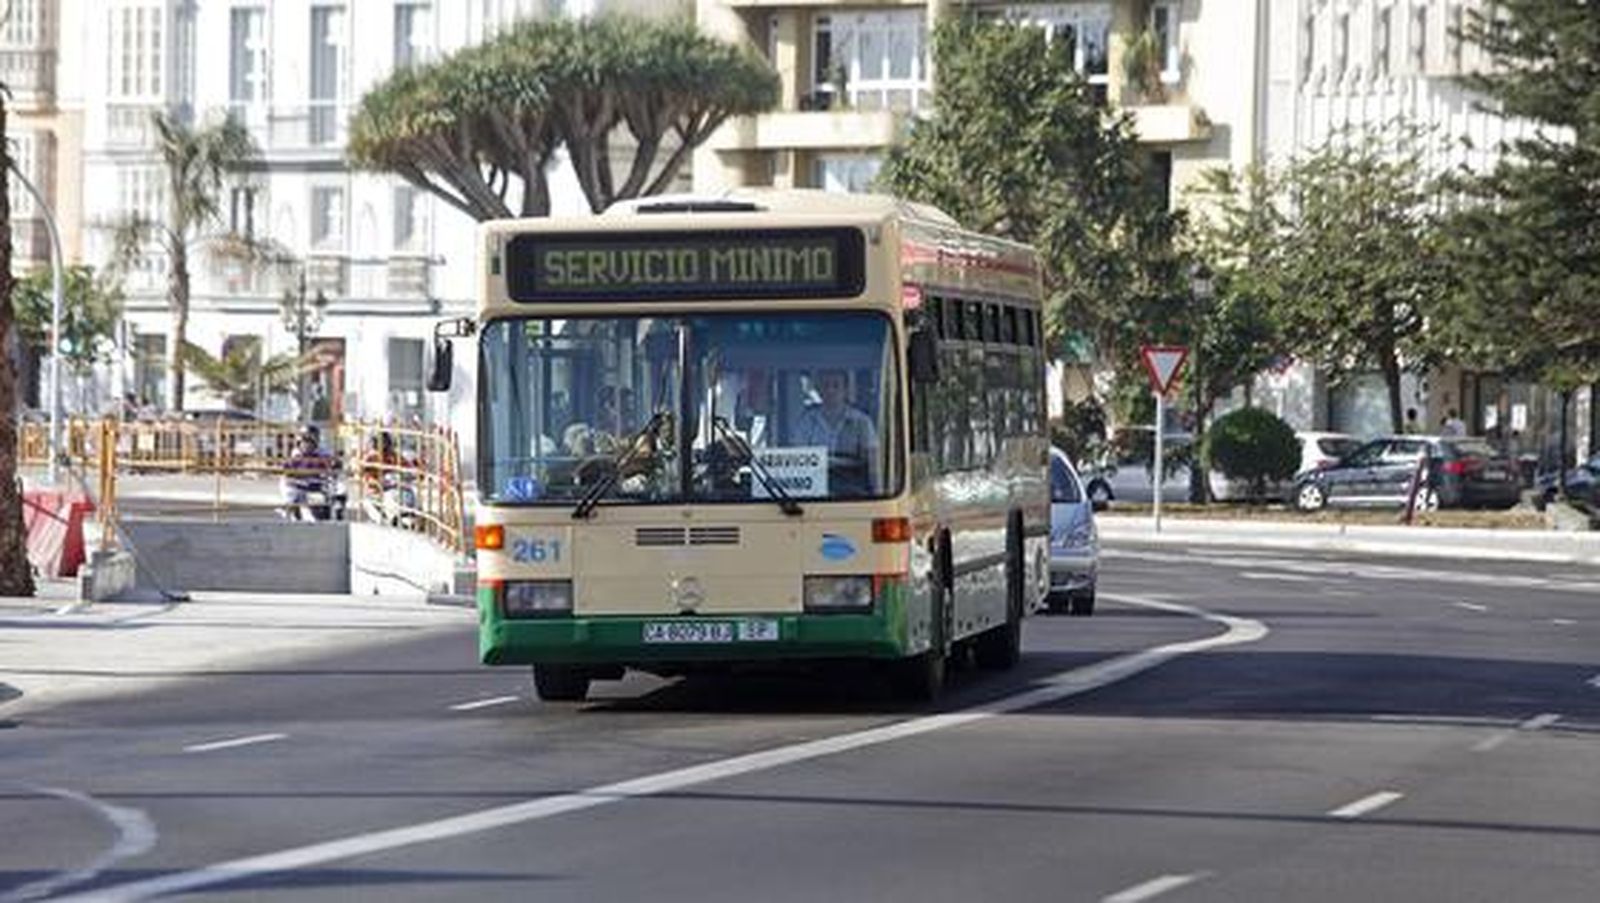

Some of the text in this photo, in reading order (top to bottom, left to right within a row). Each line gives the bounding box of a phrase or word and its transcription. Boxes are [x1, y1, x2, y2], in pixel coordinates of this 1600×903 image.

[543, 246, 834, 286] SERVICIO MINIMO
[512, 540, 563, 563] 261
